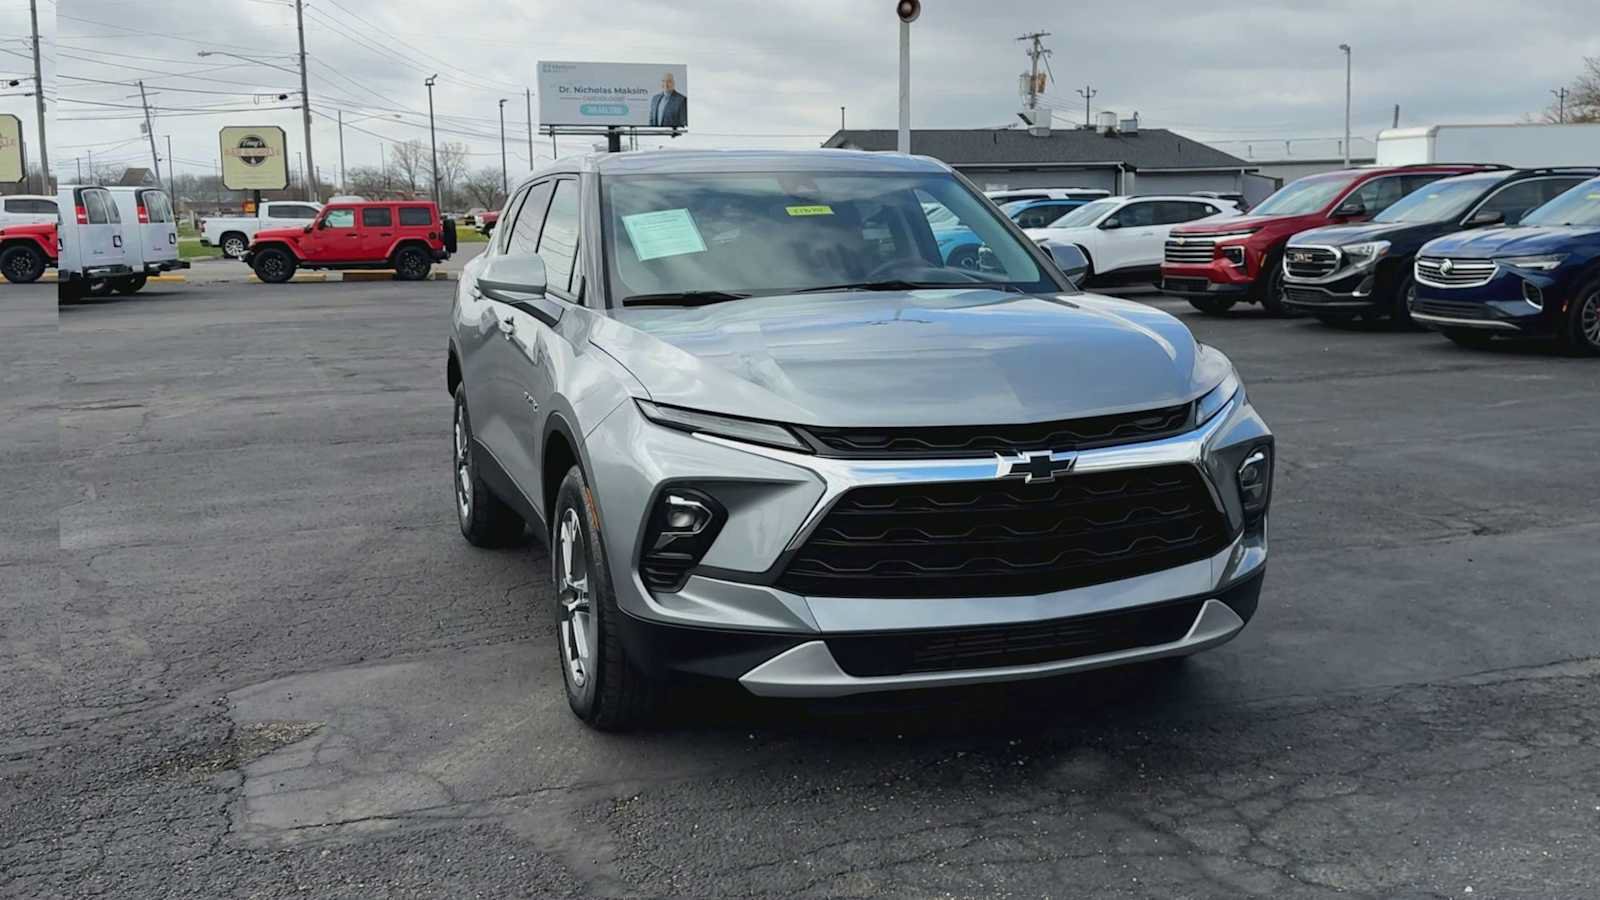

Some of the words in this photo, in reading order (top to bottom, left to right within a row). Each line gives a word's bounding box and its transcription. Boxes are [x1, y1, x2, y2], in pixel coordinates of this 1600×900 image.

[559, 86, 572, 94] Dr.
[574, 86, 612, 95] Nicholas
[614, 87, 648, 95] Maksim
